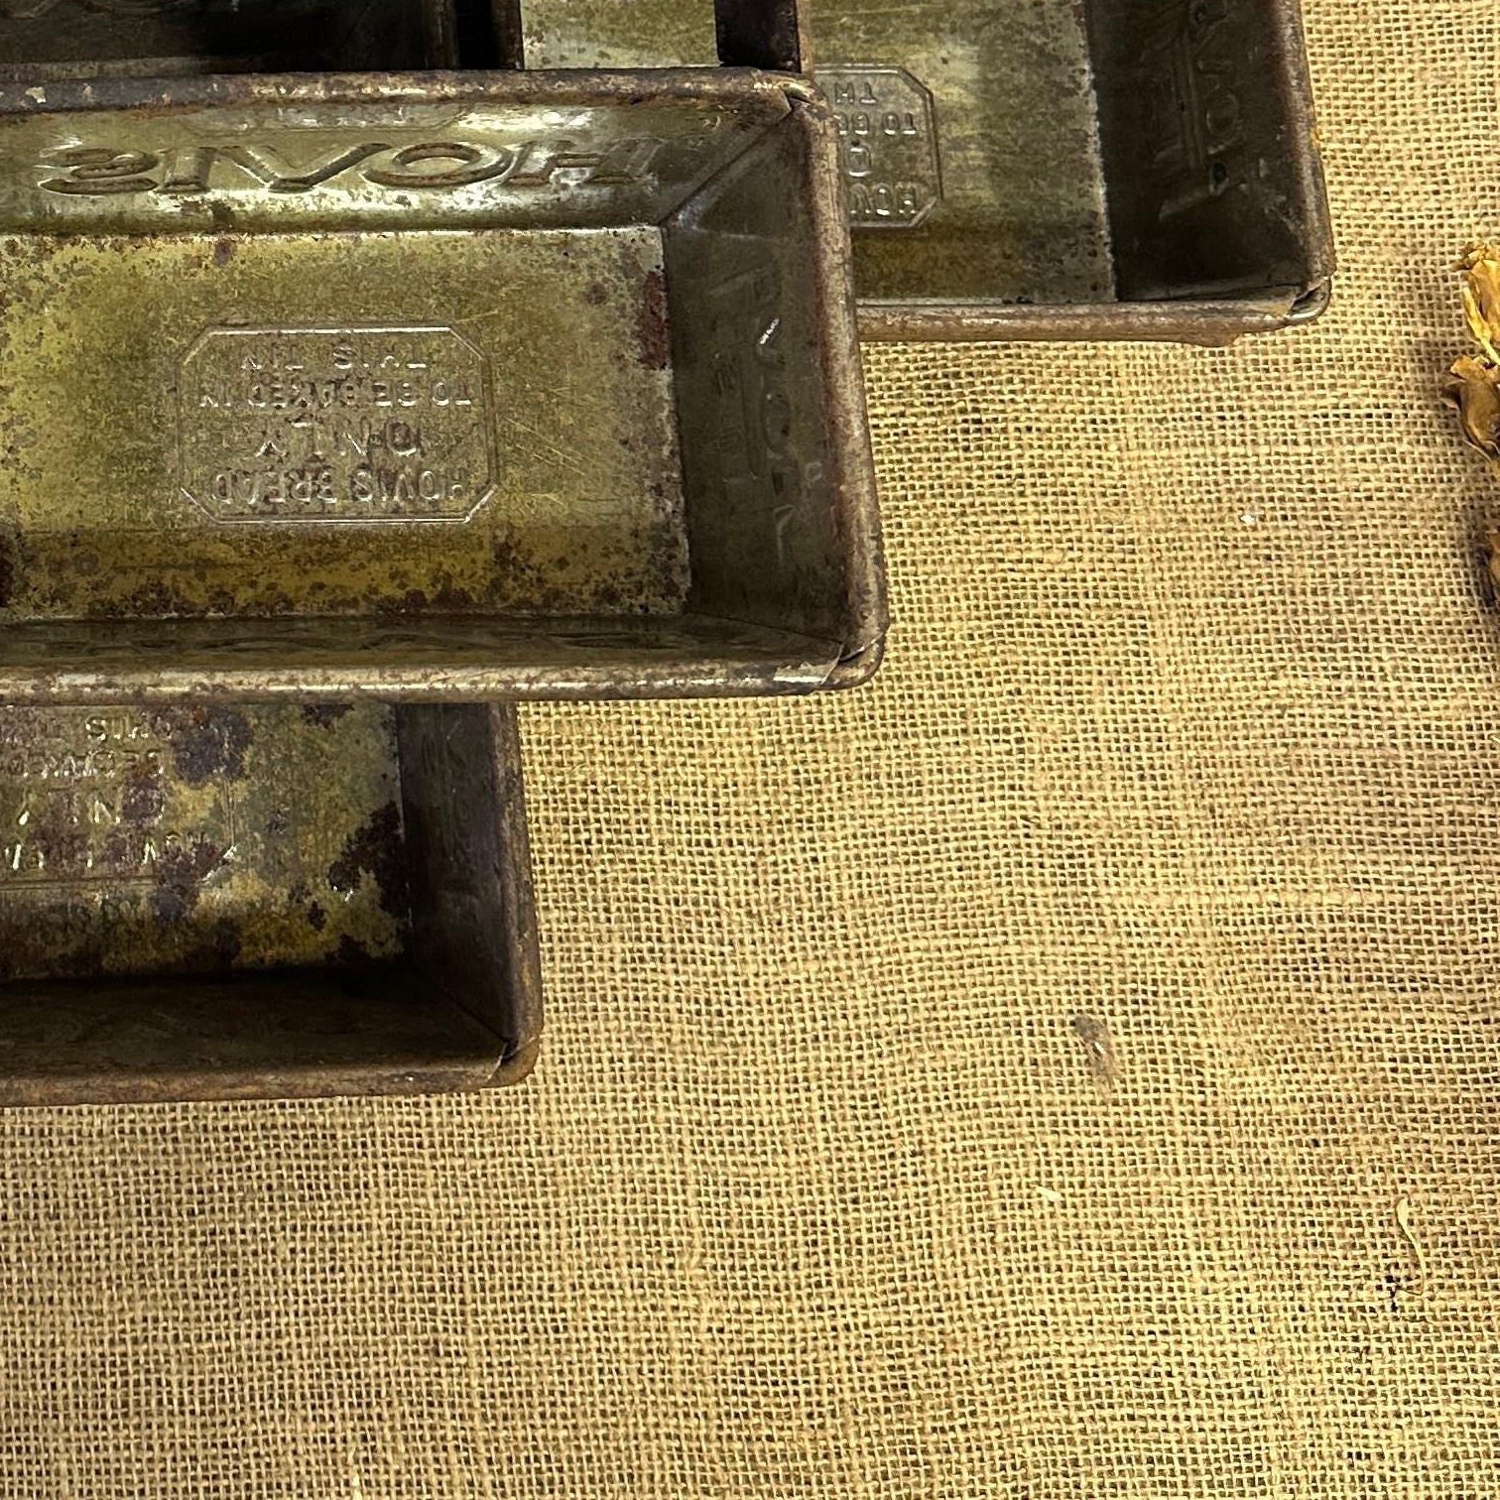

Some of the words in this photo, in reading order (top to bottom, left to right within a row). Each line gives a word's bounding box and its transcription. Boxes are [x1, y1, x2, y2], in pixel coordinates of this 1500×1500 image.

[430, 380, 473, 408] TO
[253, 420, 419, 459] ONLY
[208, 467, 339, 507] BREAD
[348, 466, 467, 506] HOVIS
